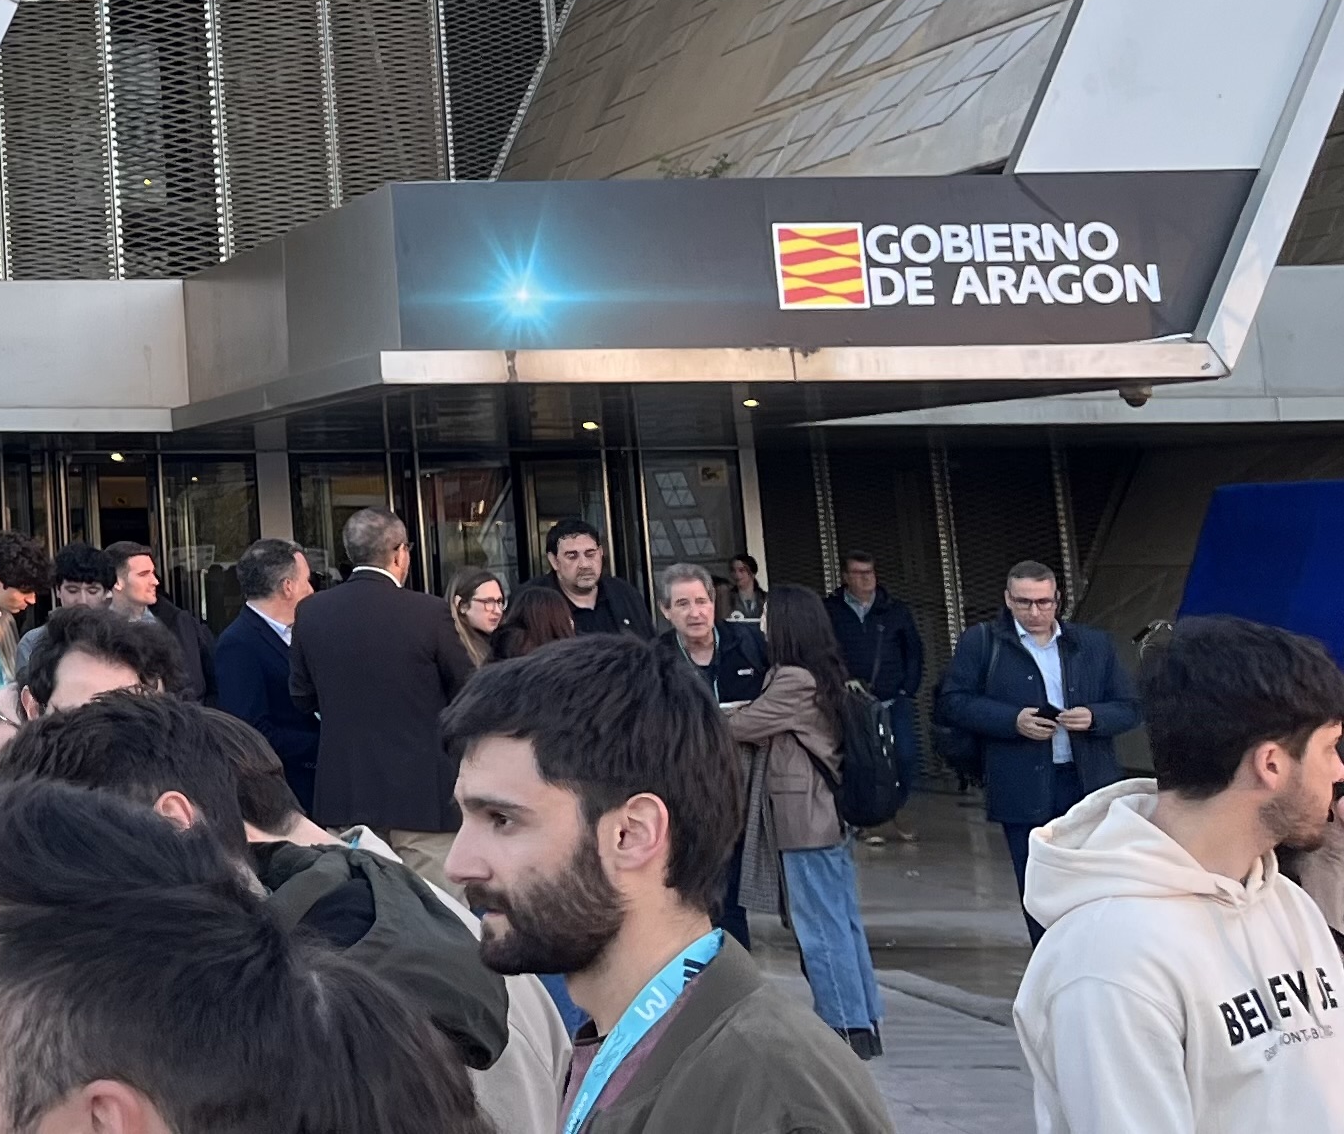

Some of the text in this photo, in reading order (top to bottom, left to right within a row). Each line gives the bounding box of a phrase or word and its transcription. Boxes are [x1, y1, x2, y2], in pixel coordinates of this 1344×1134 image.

[865, 221, 1120, 264] GOBIERNO
[869, 263, 1161, 305] DE ARAGON
